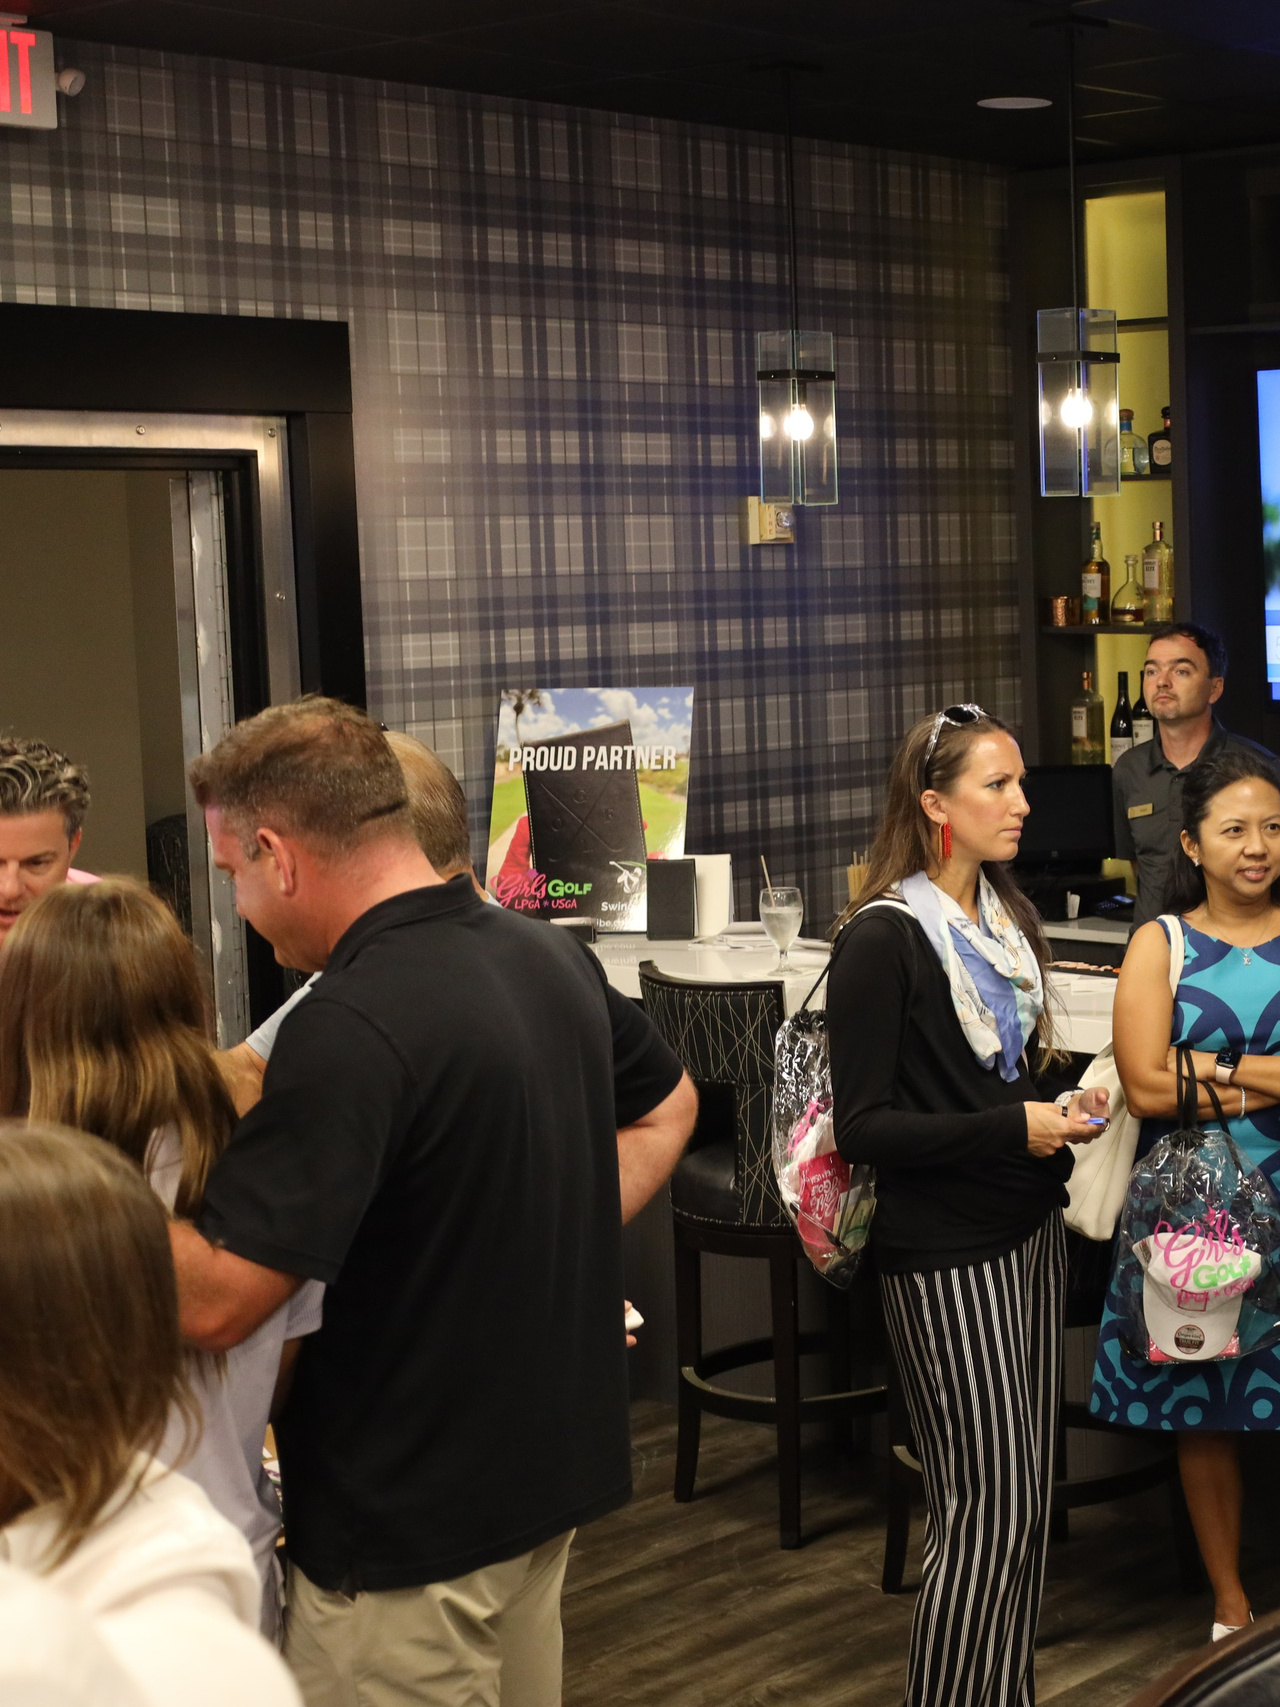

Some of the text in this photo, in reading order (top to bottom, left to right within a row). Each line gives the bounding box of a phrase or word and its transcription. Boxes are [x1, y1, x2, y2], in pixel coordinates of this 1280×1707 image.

[508, 744, 676, 772] PROUD PARTNER
[490, 873, 547, 909] Girls
[547, 878, 593, 897] GOLF
[514, 897, 577, 910] LPGA USGA
[1153, 1209, 1245, 1288] Girls
[1193, 1255, 1251, 1288] GOLF
